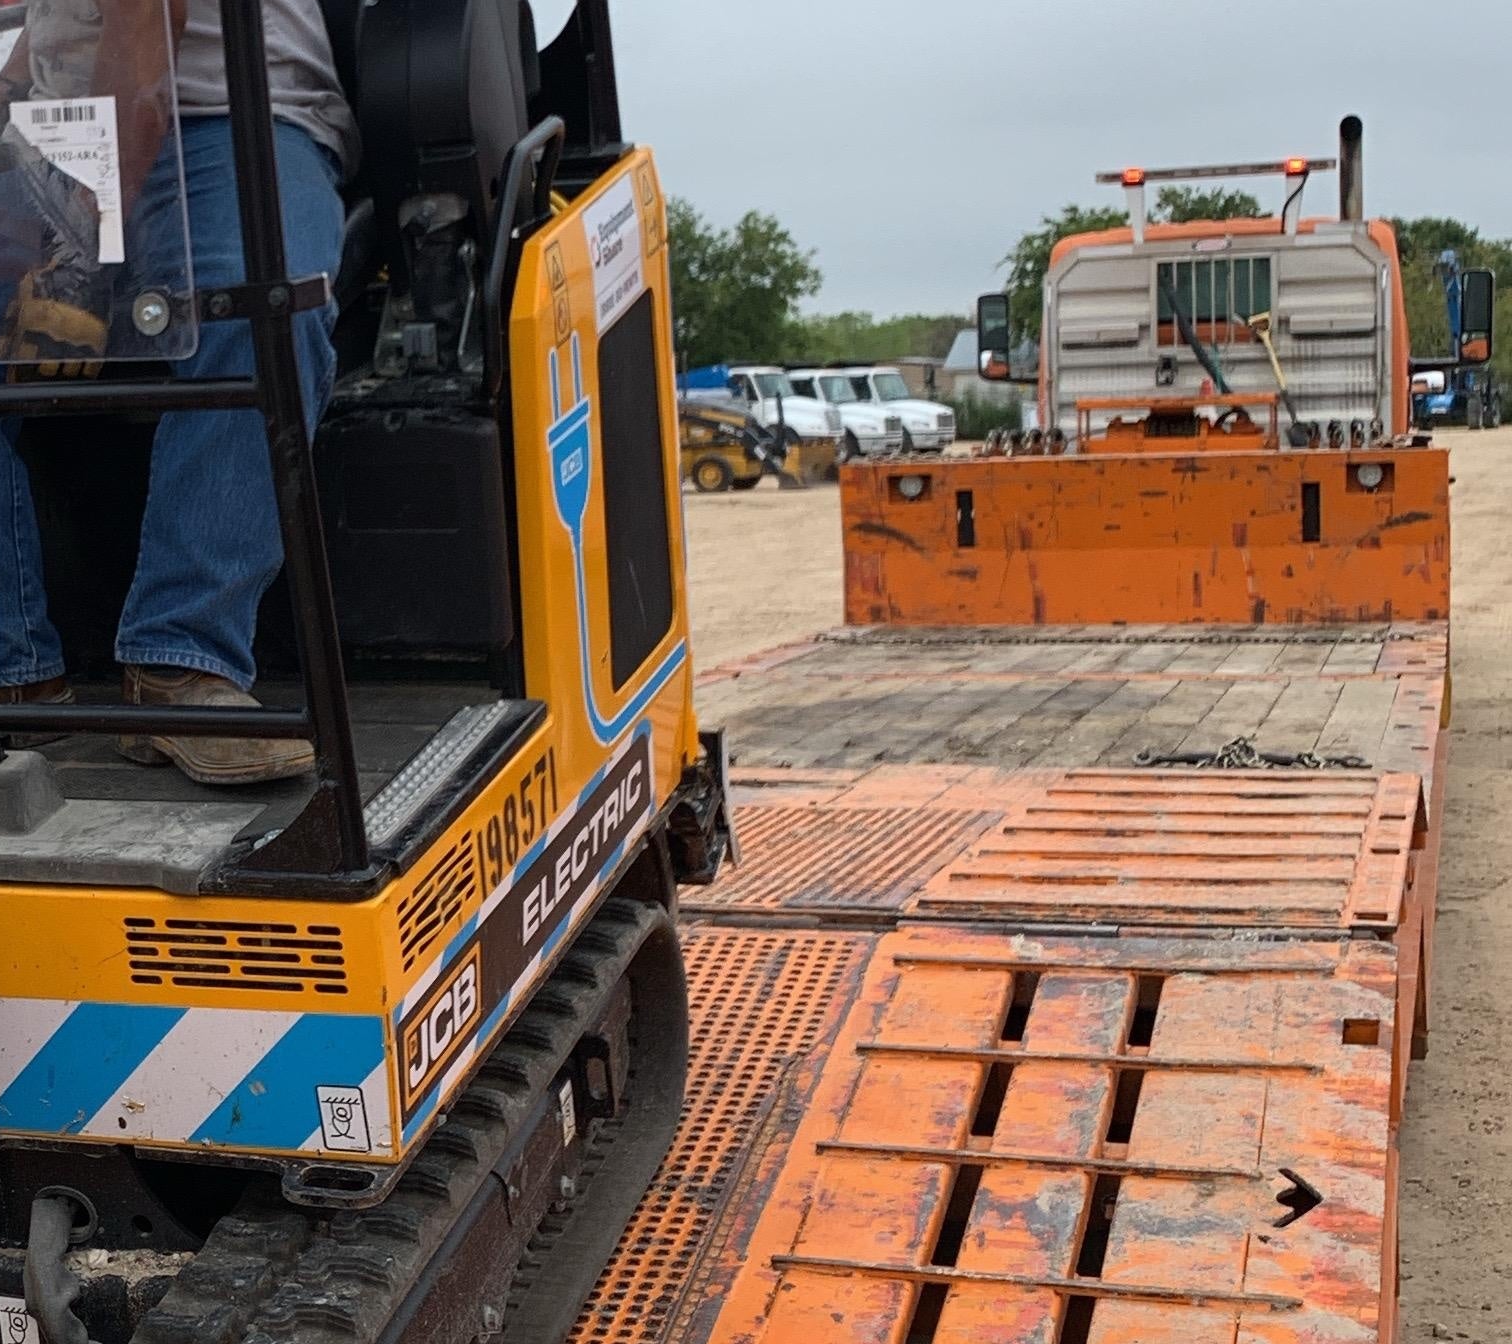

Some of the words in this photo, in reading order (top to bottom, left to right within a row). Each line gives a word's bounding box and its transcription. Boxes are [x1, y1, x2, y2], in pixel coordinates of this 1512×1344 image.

[477, 746, 558, 903] 198571
[522, 759, 643, 947] ELECTRIC
[409, 962, 477, 1089] JCB
